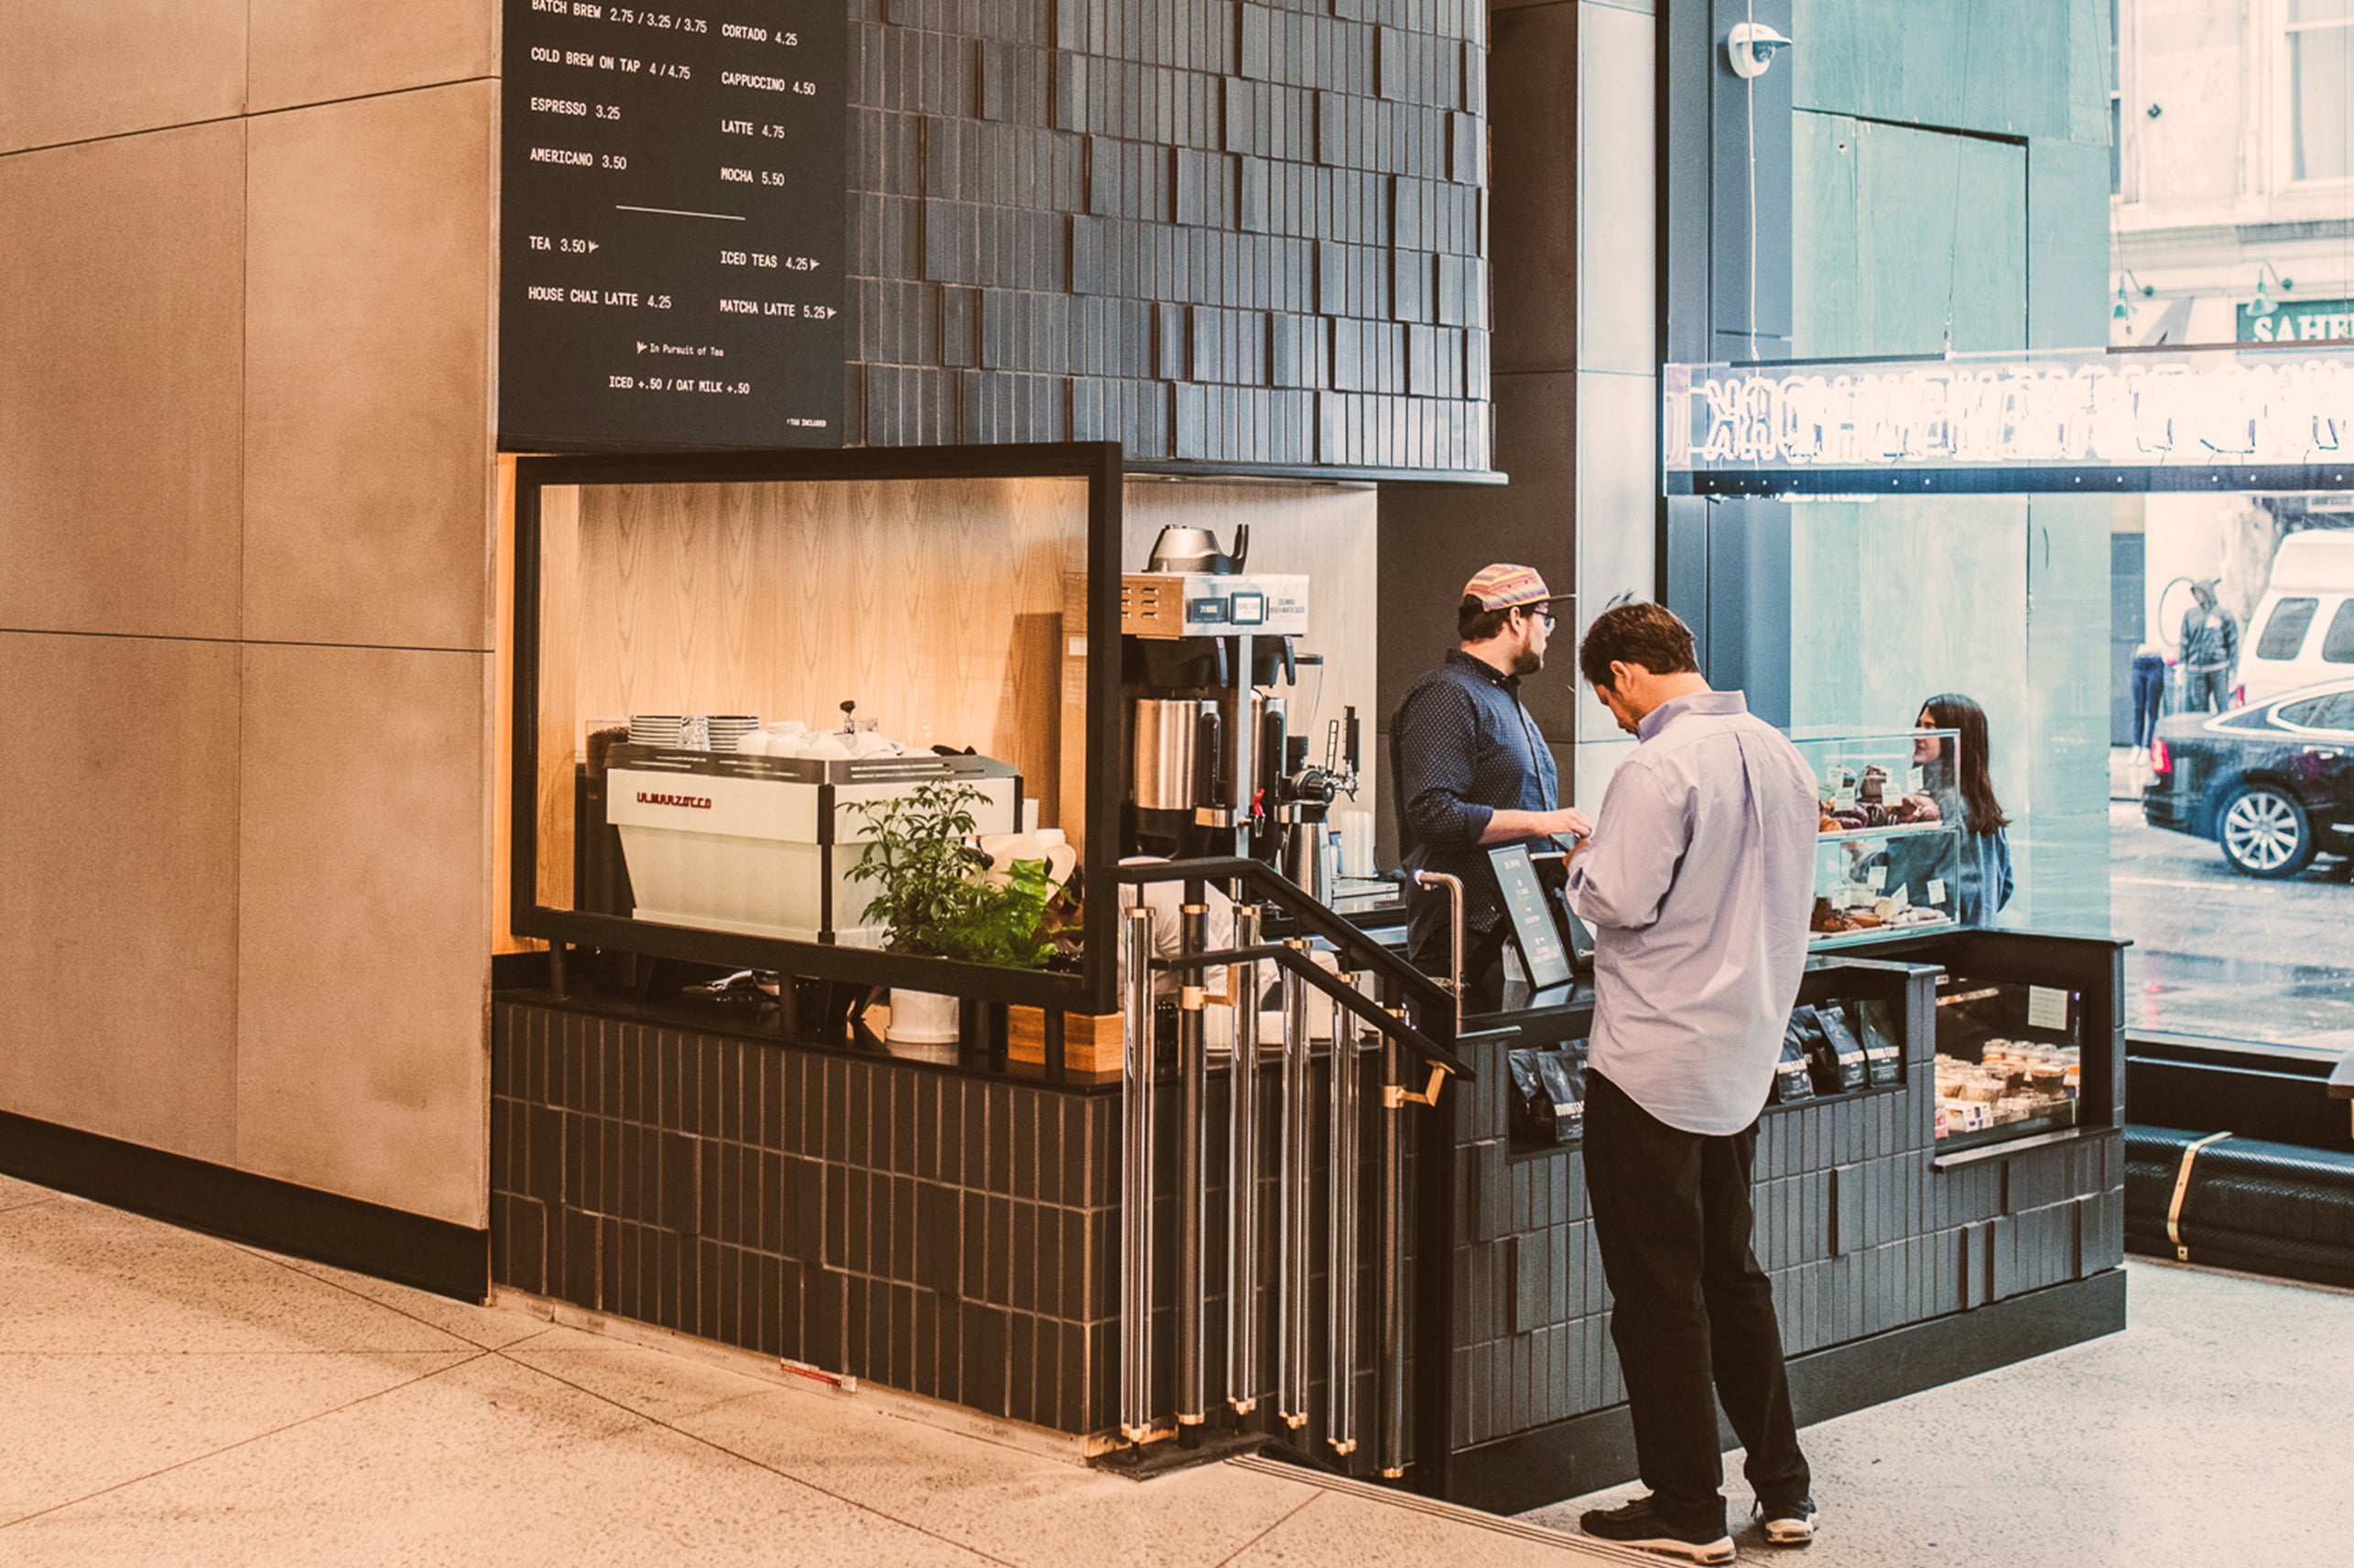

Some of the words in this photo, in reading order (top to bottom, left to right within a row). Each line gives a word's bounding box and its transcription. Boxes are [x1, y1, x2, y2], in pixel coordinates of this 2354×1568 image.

[532, 0, 568, 15] BATCH
[572, 2, 602, 19] BREW
[610, 7, 635, 24] 2.75
[646, 13, 671, 29] 3.25
[684, 17, 708, 34] 3.75
[721, 23, 767, 42] CORTADO
[775, 32, 797, 47] 4.25
[530, 47, 560, 63] COLD
[566, 50, 595, 68] BREW
[599, 55, 614, 70] ON
[620, 58, 641, 73] TAP
[648, 62, 656, 75] 4
[667, 64, 691, 80] 4.75
[721, 70, 786, 92] CAPPUCCINO
[792, 81, 816, 96] 4.50
[530, 96, 587, 116] ESPRESSO
[595, 104, 621, 121] 3.25
[721, 119, 754, 135] LATTE
[761, 124, 786, 139] 4.75
[529, 147, 593, 167] AMERICANO
[602, 154, 627, 170] 3.50
[721, 167, 754, 183] MOCHA
[761, 171, 786, 187] 5.50
[528, 235, 551, 251] TEA
[560, 238, 586, 254] 3.50
[720, 250, 747, 265] ICED
[751, 253, 778, 268] TEAS
[785, 256, 808, 271] 4.25
[527, 286, 564, 302] HOUSE
[570, 288, 599, 305] CHAI
[604, 291, 638, 308] LATTE
[646, 295, 672, 309] 4.25
[720, 298, 759, 315] MATCHA
[764, 302, 796, 318] LATTE
[803, 305, 826, 319] 5.25
[649, 342, 659, 353] In
[662, 343, 694, 355] Pursuit
[697, 346, 707, 356] of
[710, 346, 724, 357] Tea
[609, 375, 634, 389] ICED
[637, 377, 663, 391] +.50
[676, 379, 695, 392] OAT
[698, 380, 723, 394] MILK
[726, 382, 751, 395] +.50
